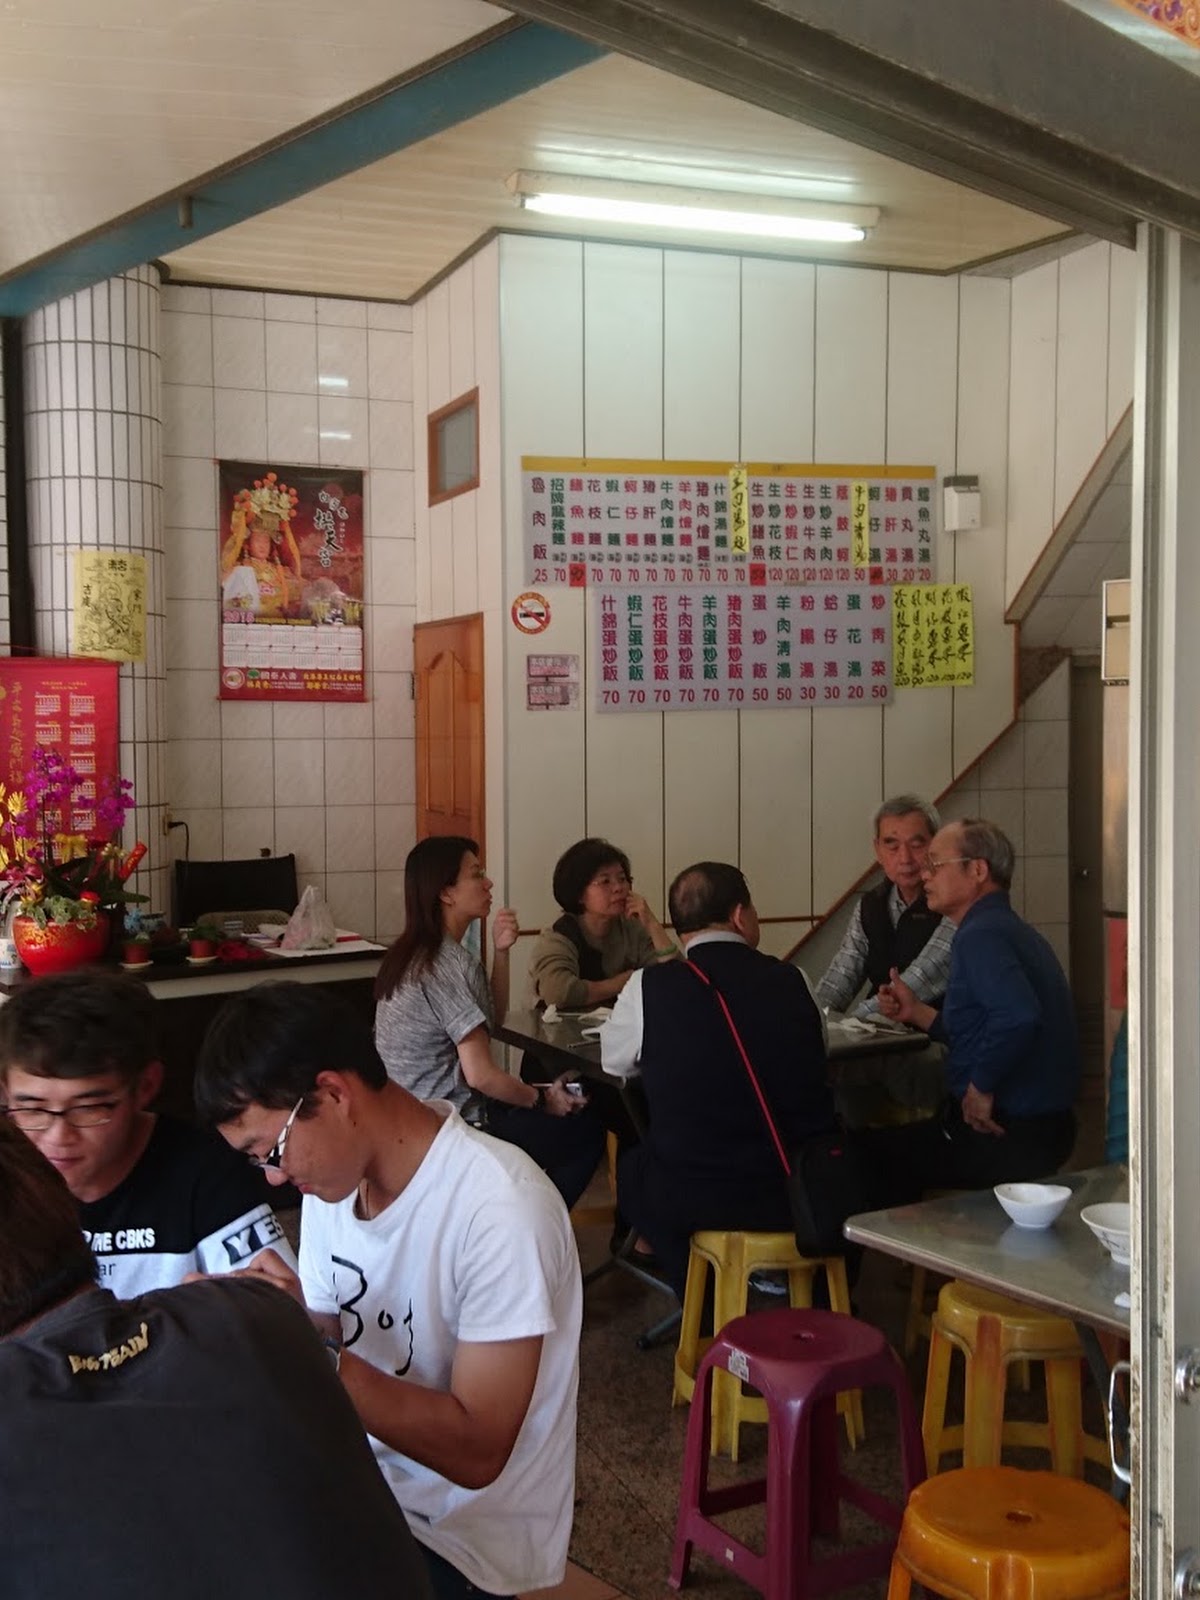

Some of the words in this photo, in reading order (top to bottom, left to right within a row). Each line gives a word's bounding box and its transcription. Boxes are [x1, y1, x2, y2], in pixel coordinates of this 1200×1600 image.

[532, 477, 547, 560] 魯肉飯
[588, 480, 601, 545] 花枝麵
[606, 480, 620, 546] 蝦仁麵
[625, 480, 638, 546] 蚵仔麵
[661, 481, 674, 546] 牛肉燴麵
[678, 481, 692, 546] 羊肉燴麵
[714, 482, 727, 548] 什錦湯麵
[769, 483, 781, 560] 生炒花枝
[785, 484, 798, 560] 生炒蝦仁
[803, 484, 815, 561] 生炒牛肉
[820, 485, 832, 561] 生炒羊肉
[902, 487, 914, 563] 貢丸湯
[535, 569, 547, 582] 25
[555, 569, 566, 581] 70
[592, 570, 603, 582] 70
[610, 570, 621, 582] 70
[628, 570, 639, 582] 70
[646, 570, 657, 582] 70
[664, 570, 675, 582] 70
[682, 570, 693, 582] 70
[699, 570, 710, 581] 70
[717, 570, 728, 581] 70
[735, 569, 745, 581] 70
[769, 568, 782, 581] 120
[787, 568, 799, 581] 120
[803, 568, 816, 581] 120
[820, 568, 833, 581] 120
[837, 568, 849, 581] 120
[855, 569, 865, 581] 50
[888, 569, 897, 581] 30
[903, 569, 914, 580] 20
[920, 569, 930, 580] 20
[601, 595, 618, 681] 什錦蛋炒飯
[627, 595, 643, 680] 蝦仁蛋炒飯
[653, 595, 669, 680] 花枝蛋炒飯
[678, 595, 694, 680] 牛肉蛋炒飯
[703, 595, 718, 680] 羊肉蛋炒飯
[727, 595, 743, 679] 豬肉蛋炒飯
[752, 595, 767, 679] 蛋炒飯
[777, 595, 791, 679] 羊肉清湯
[800, 595, 815, 678] 粉腸湯
[824, 595, 838, 677] 蛤仔湯
[847, 595, 861, 677] 蛋花湯
[871, 595, 886, 676] 炒青菜
[603, 690, 620, 704] 70
[629, 690, 645, 703] 70
[654, 689, 670, 703] 70
[679, 689, 695, 702] 70
[703, 689, 719, 702] 70
[728, 688, 744, 702] 70
[752, 688, 768, 701] 50
[777, 687, 791, 700] 50
[800, 687, 816, 700] 30
[824, 686, 840, 699] 30
[848, 686, 864, 699] 20
[872, 686, 887, 698] 50
